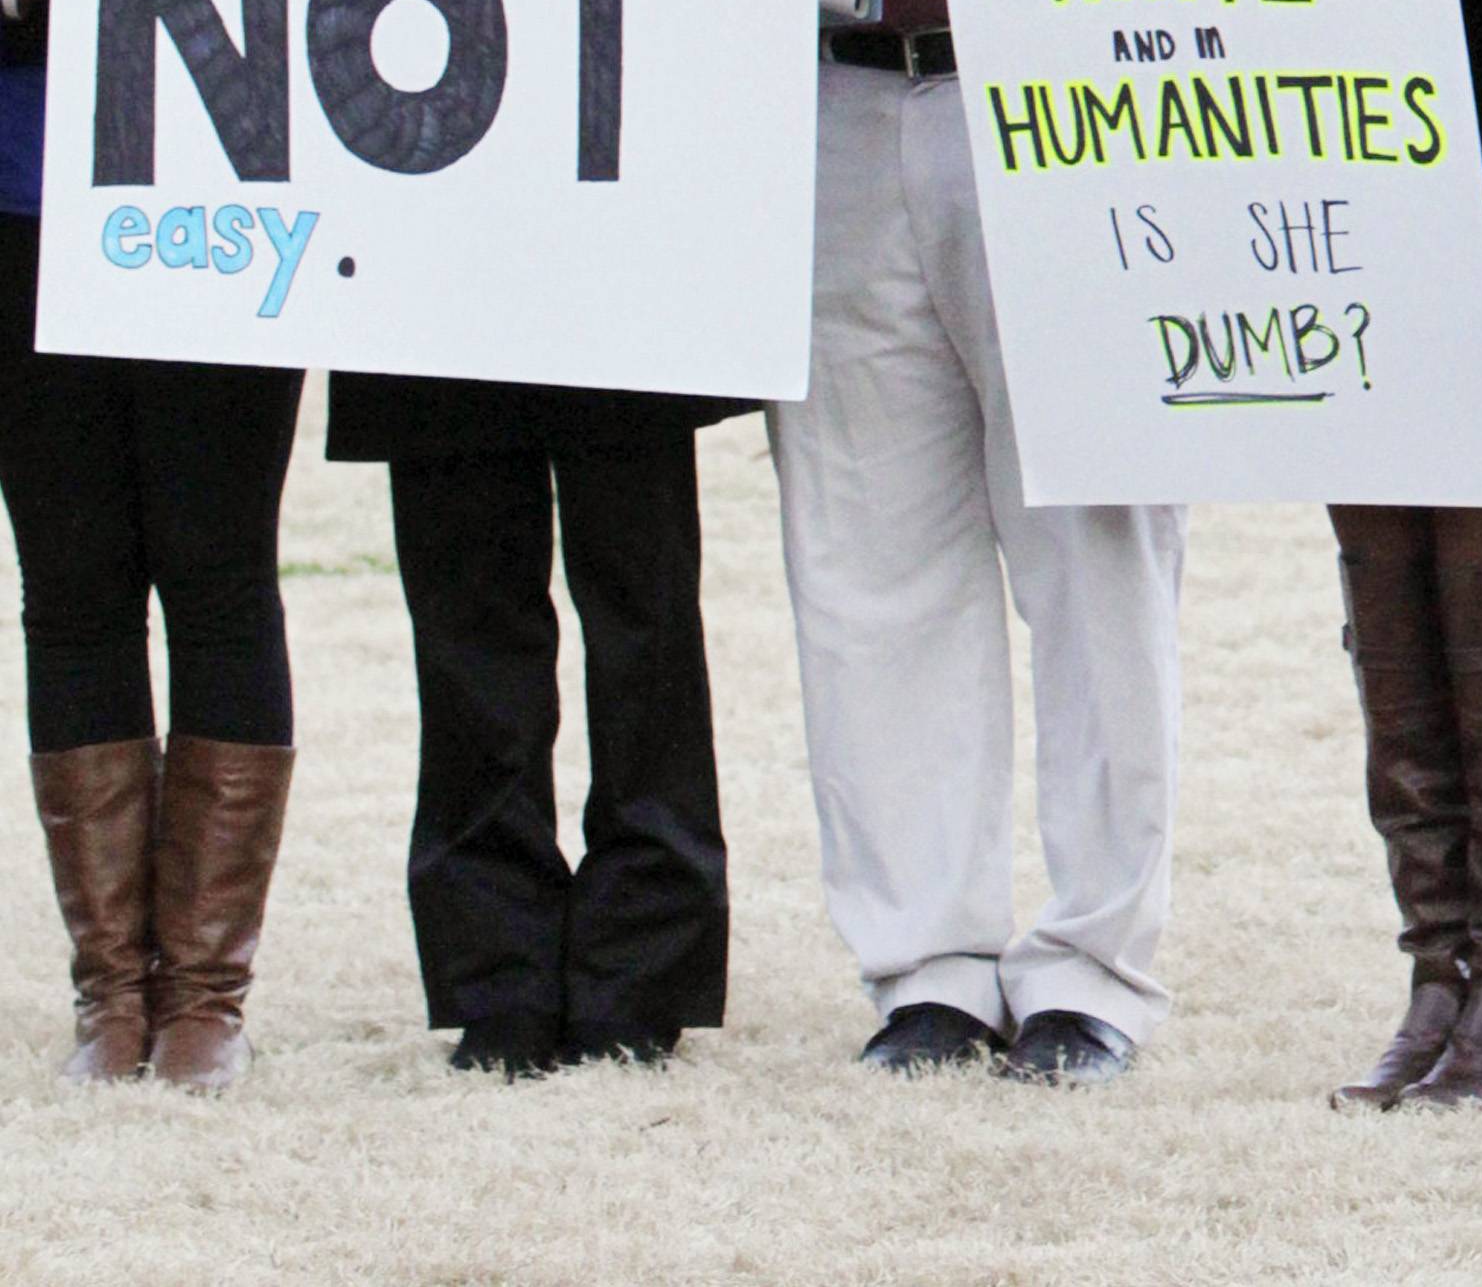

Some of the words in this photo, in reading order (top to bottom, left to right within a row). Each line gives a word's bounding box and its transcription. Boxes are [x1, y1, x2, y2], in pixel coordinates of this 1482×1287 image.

[1113, 29, 1176, 62] AND
[988, 77, 1443, 171] HUMANITIES
[1110, 204, 1176, 269] IS
[1250, 200, 1364, 275] SHE
[1149, 302, 1373, 391] DUMB?
